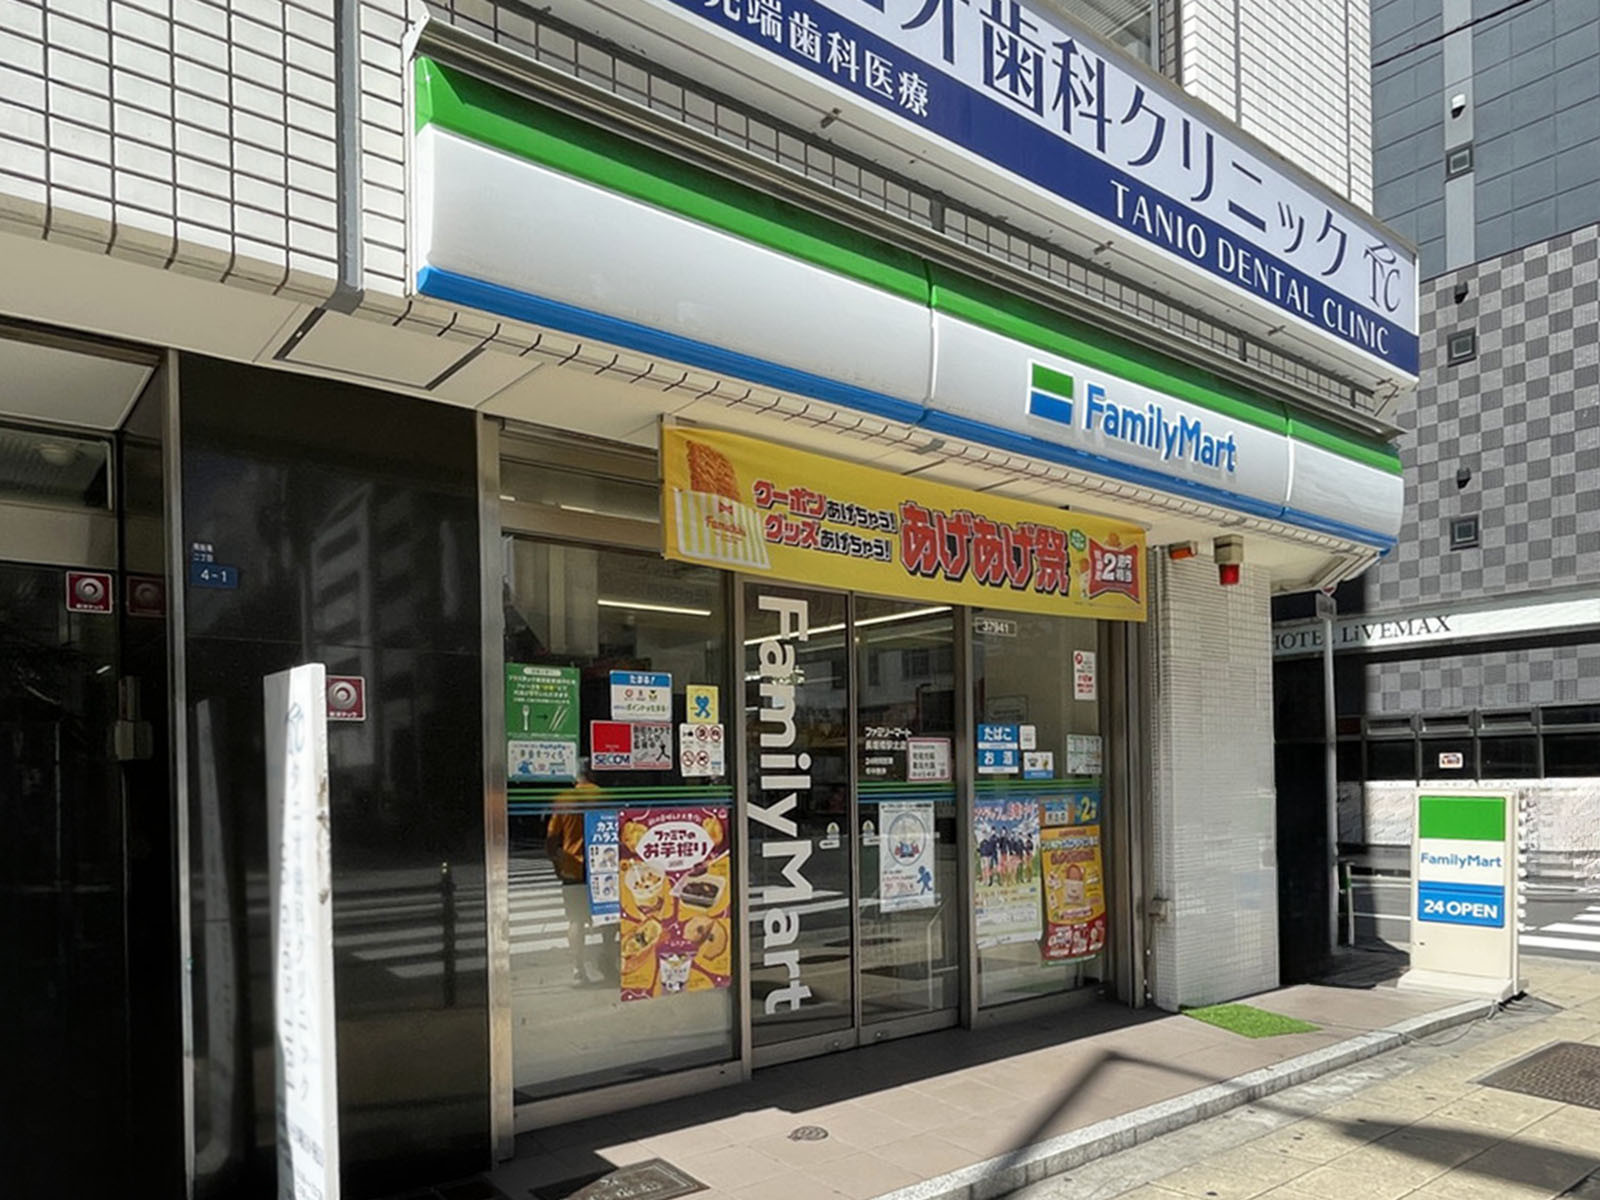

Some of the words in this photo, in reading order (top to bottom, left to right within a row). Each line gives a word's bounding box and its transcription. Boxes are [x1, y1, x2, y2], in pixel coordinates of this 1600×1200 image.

[862, 0, 1348, 276] オ歯科クリニック
[1110, 179, 1207, 259] TANIO
[1217, 236, 1315, 319] DENTAL
[1322, 298, 1390, 356] CLINIC
[1084, 382, 1238, 474] FamilyMart
[899, 501, 1070, 597] あげあげ祭
[1342, 614, 1451, 643] LiVEMAX
[594, 754, 631, 766] SECOM
[983, 726, 1013, 741] たばこ
[654, 829, 697, 842] ファミマの
[746, 594, 814, 1017] FamilyMart
[1420, 852, 1503, 869] FamilyMart
